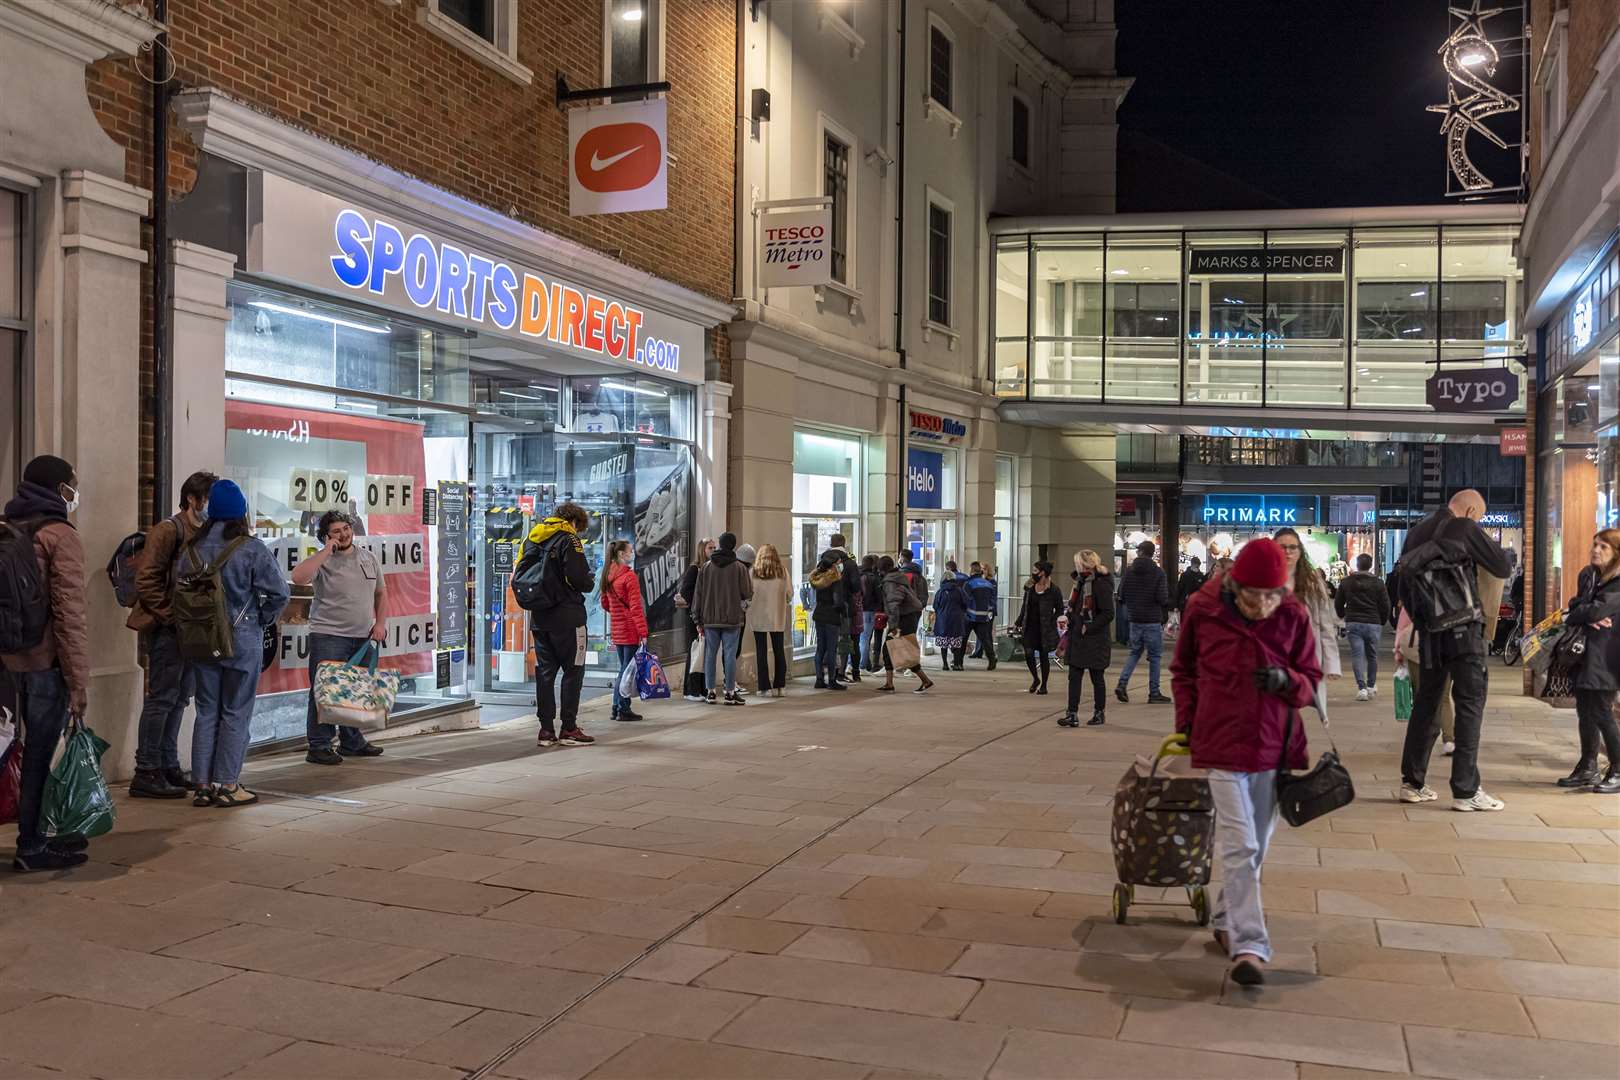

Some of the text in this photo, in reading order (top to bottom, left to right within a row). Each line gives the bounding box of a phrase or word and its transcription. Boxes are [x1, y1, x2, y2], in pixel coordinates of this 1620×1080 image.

[765, 225, 824, 241] TESCO
[765, 247, 824, 263] Metro
[1198, 255, 1334, 268] MARKS & SPENCER
[1437, 377, 1507, 404] Typo
[908, 465, 935, 492] Hello
[294, 477, 411, 506] 20% OFF
[1203, 507, 1297, 522] PRIMARK
